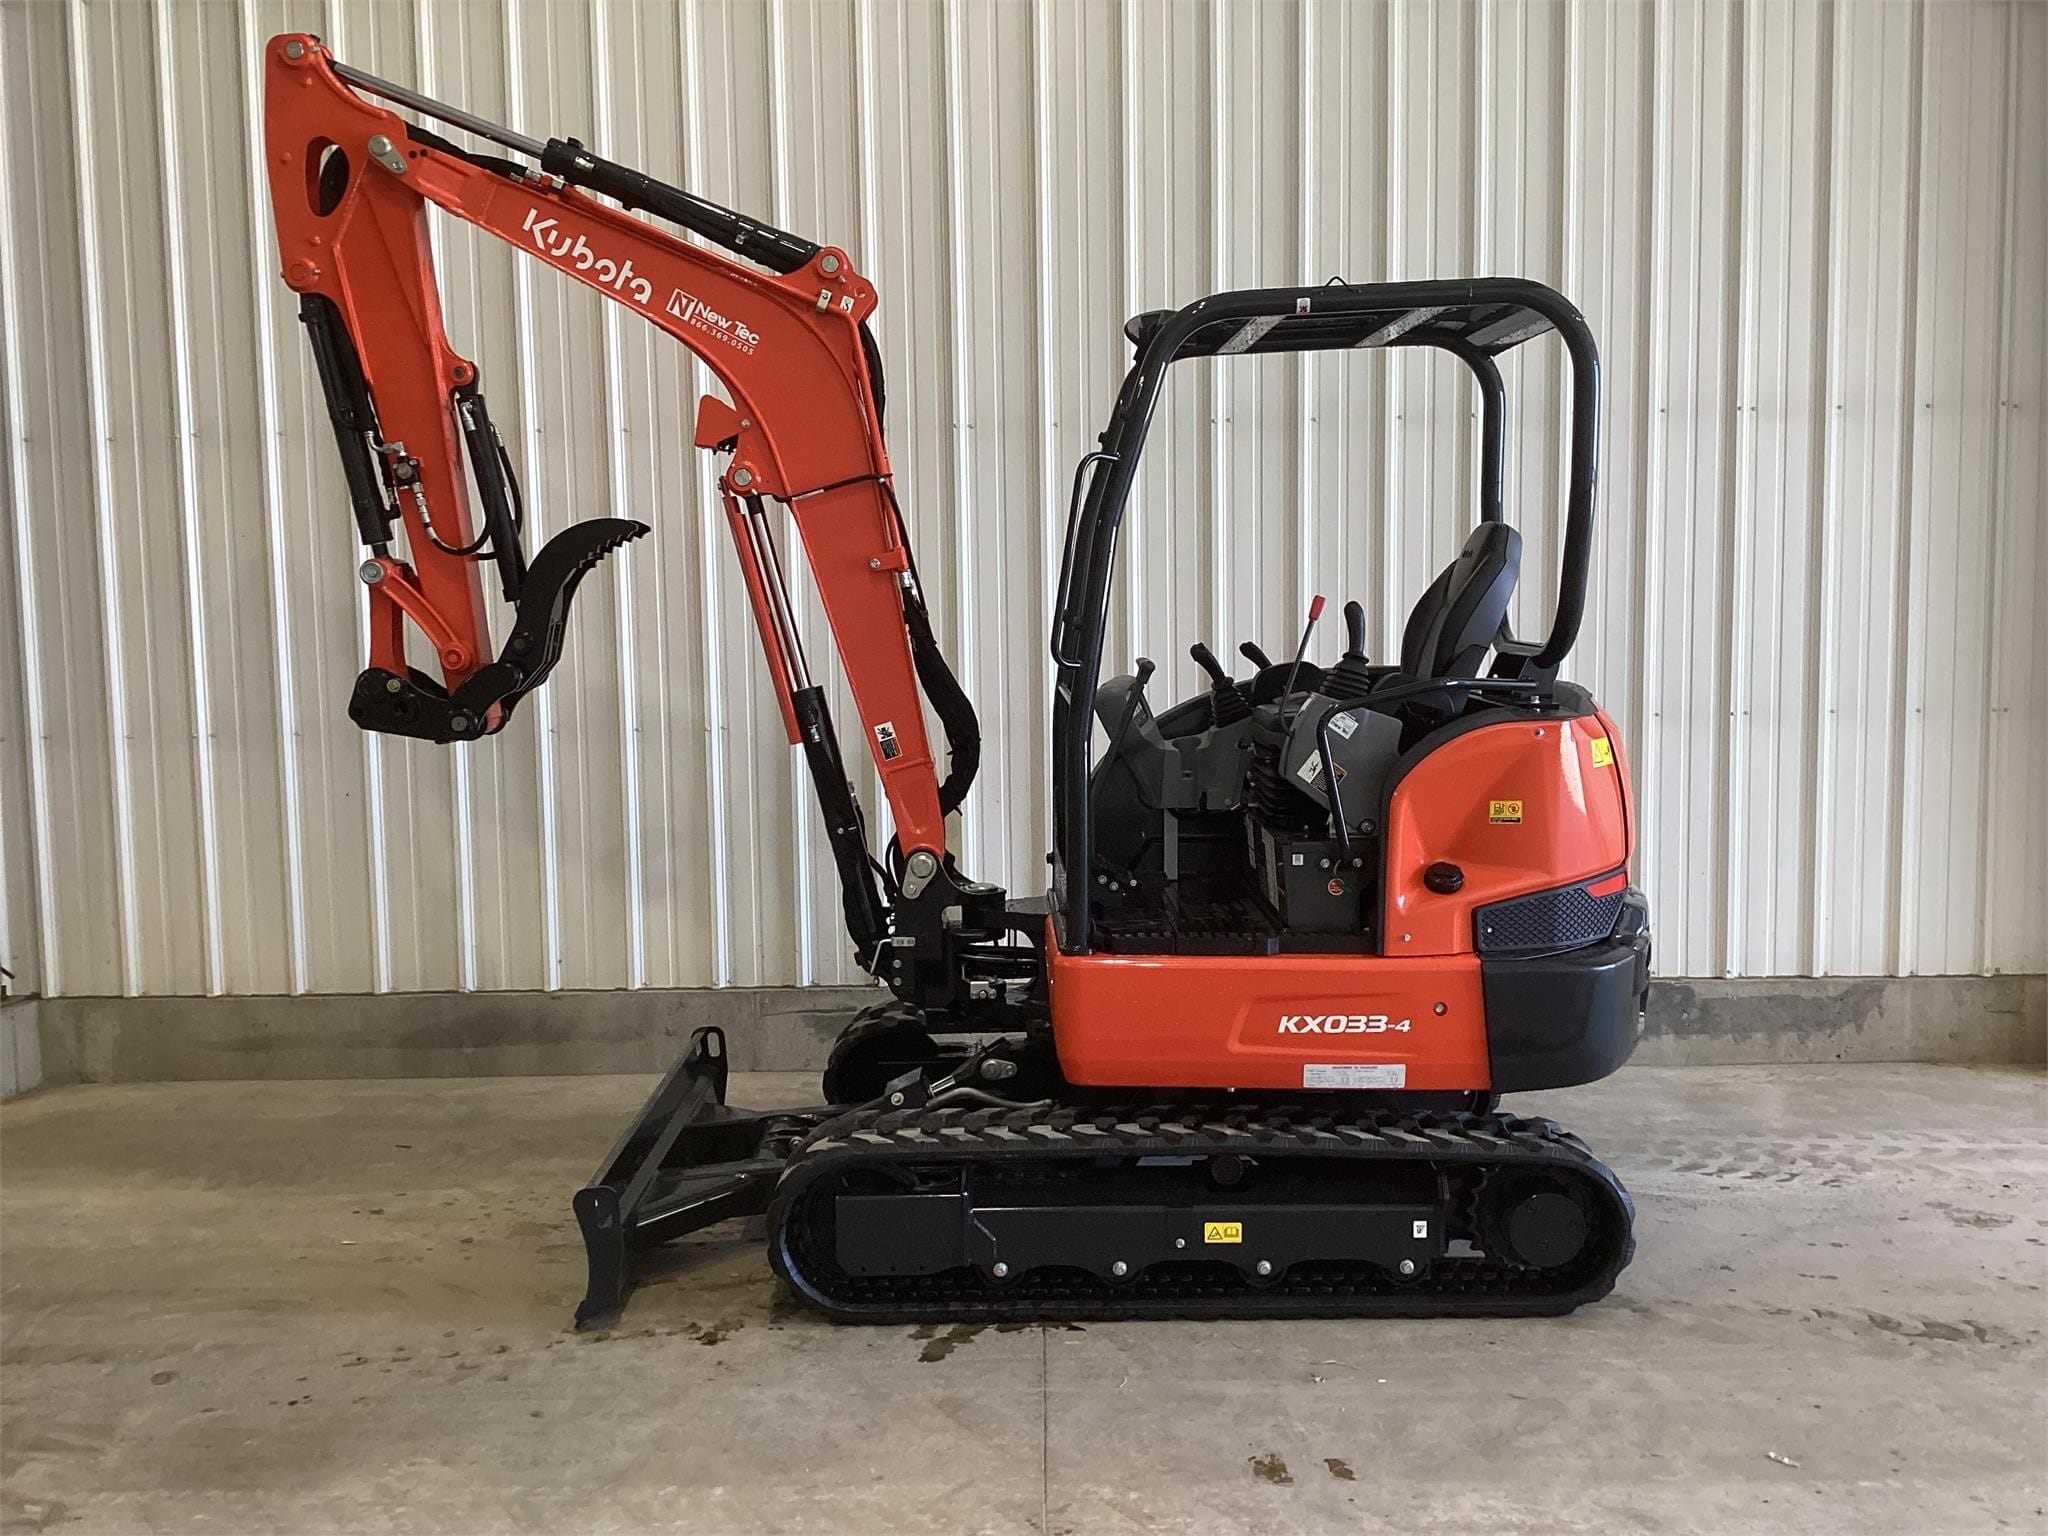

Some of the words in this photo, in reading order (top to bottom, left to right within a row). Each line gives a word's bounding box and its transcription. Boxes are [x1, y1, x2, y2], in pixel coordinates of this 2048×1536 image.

[522, 208, 652, 304] Kubota
[690, 318, 755, 355] 866.369.0505
[694, 301, 733, 329] New
[734, 320, 760, 345] Tec
[1277, 1015, 1411, 1033] KX033-4
